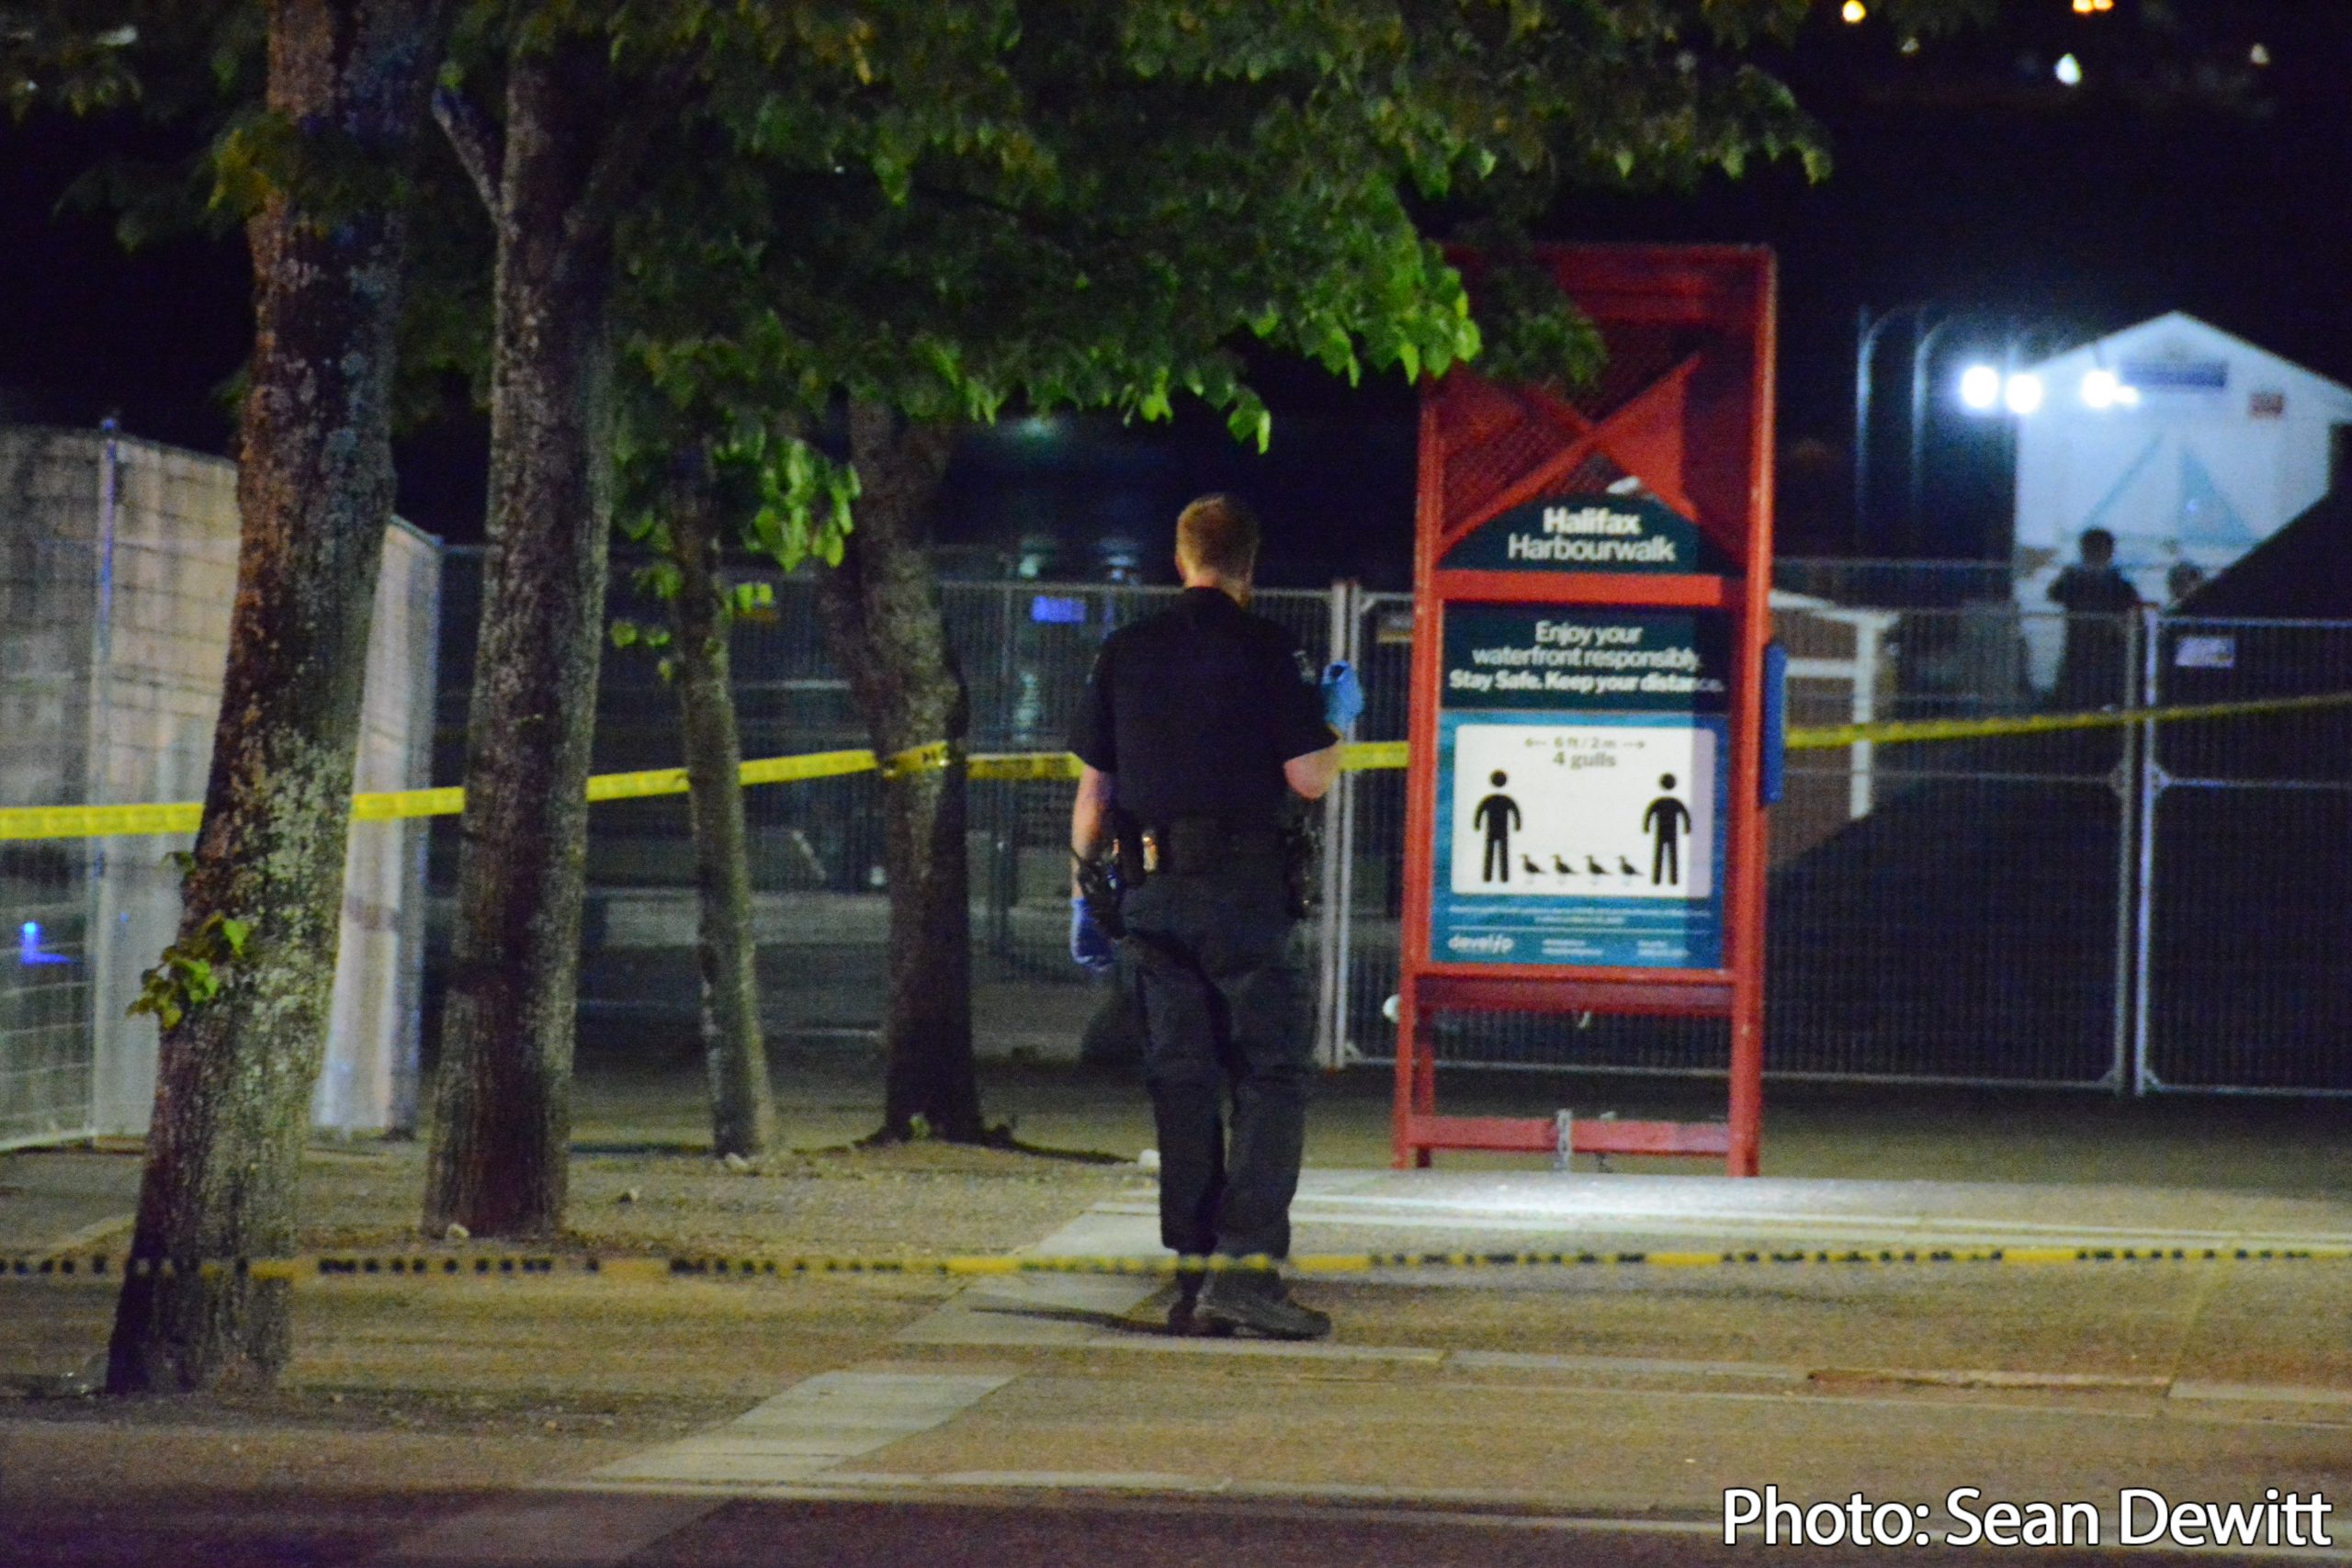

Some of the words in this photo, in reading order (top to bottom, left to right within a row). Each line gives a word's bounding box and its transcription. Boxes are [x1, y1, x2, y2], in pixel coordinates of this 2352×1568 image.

[1543, 507, 1642, 536] Halifax
[1508, 533, 1677, 562] Harbourwalk
[1535, 620, 1594, 646] Enjoy
[1595, 626, 1644, 646] your
[1472, 646, 1582, 667] waterfront
[1449, 669, 1493, 692] Stay
[1544, 671, 1594, 694] Keep
[1595, 674, 1640, 694] your
[1591, 736, 1600, 750] 2
[1552, 750, 1565, 766] 4
[1569, 751, 1617, 771] gulls
